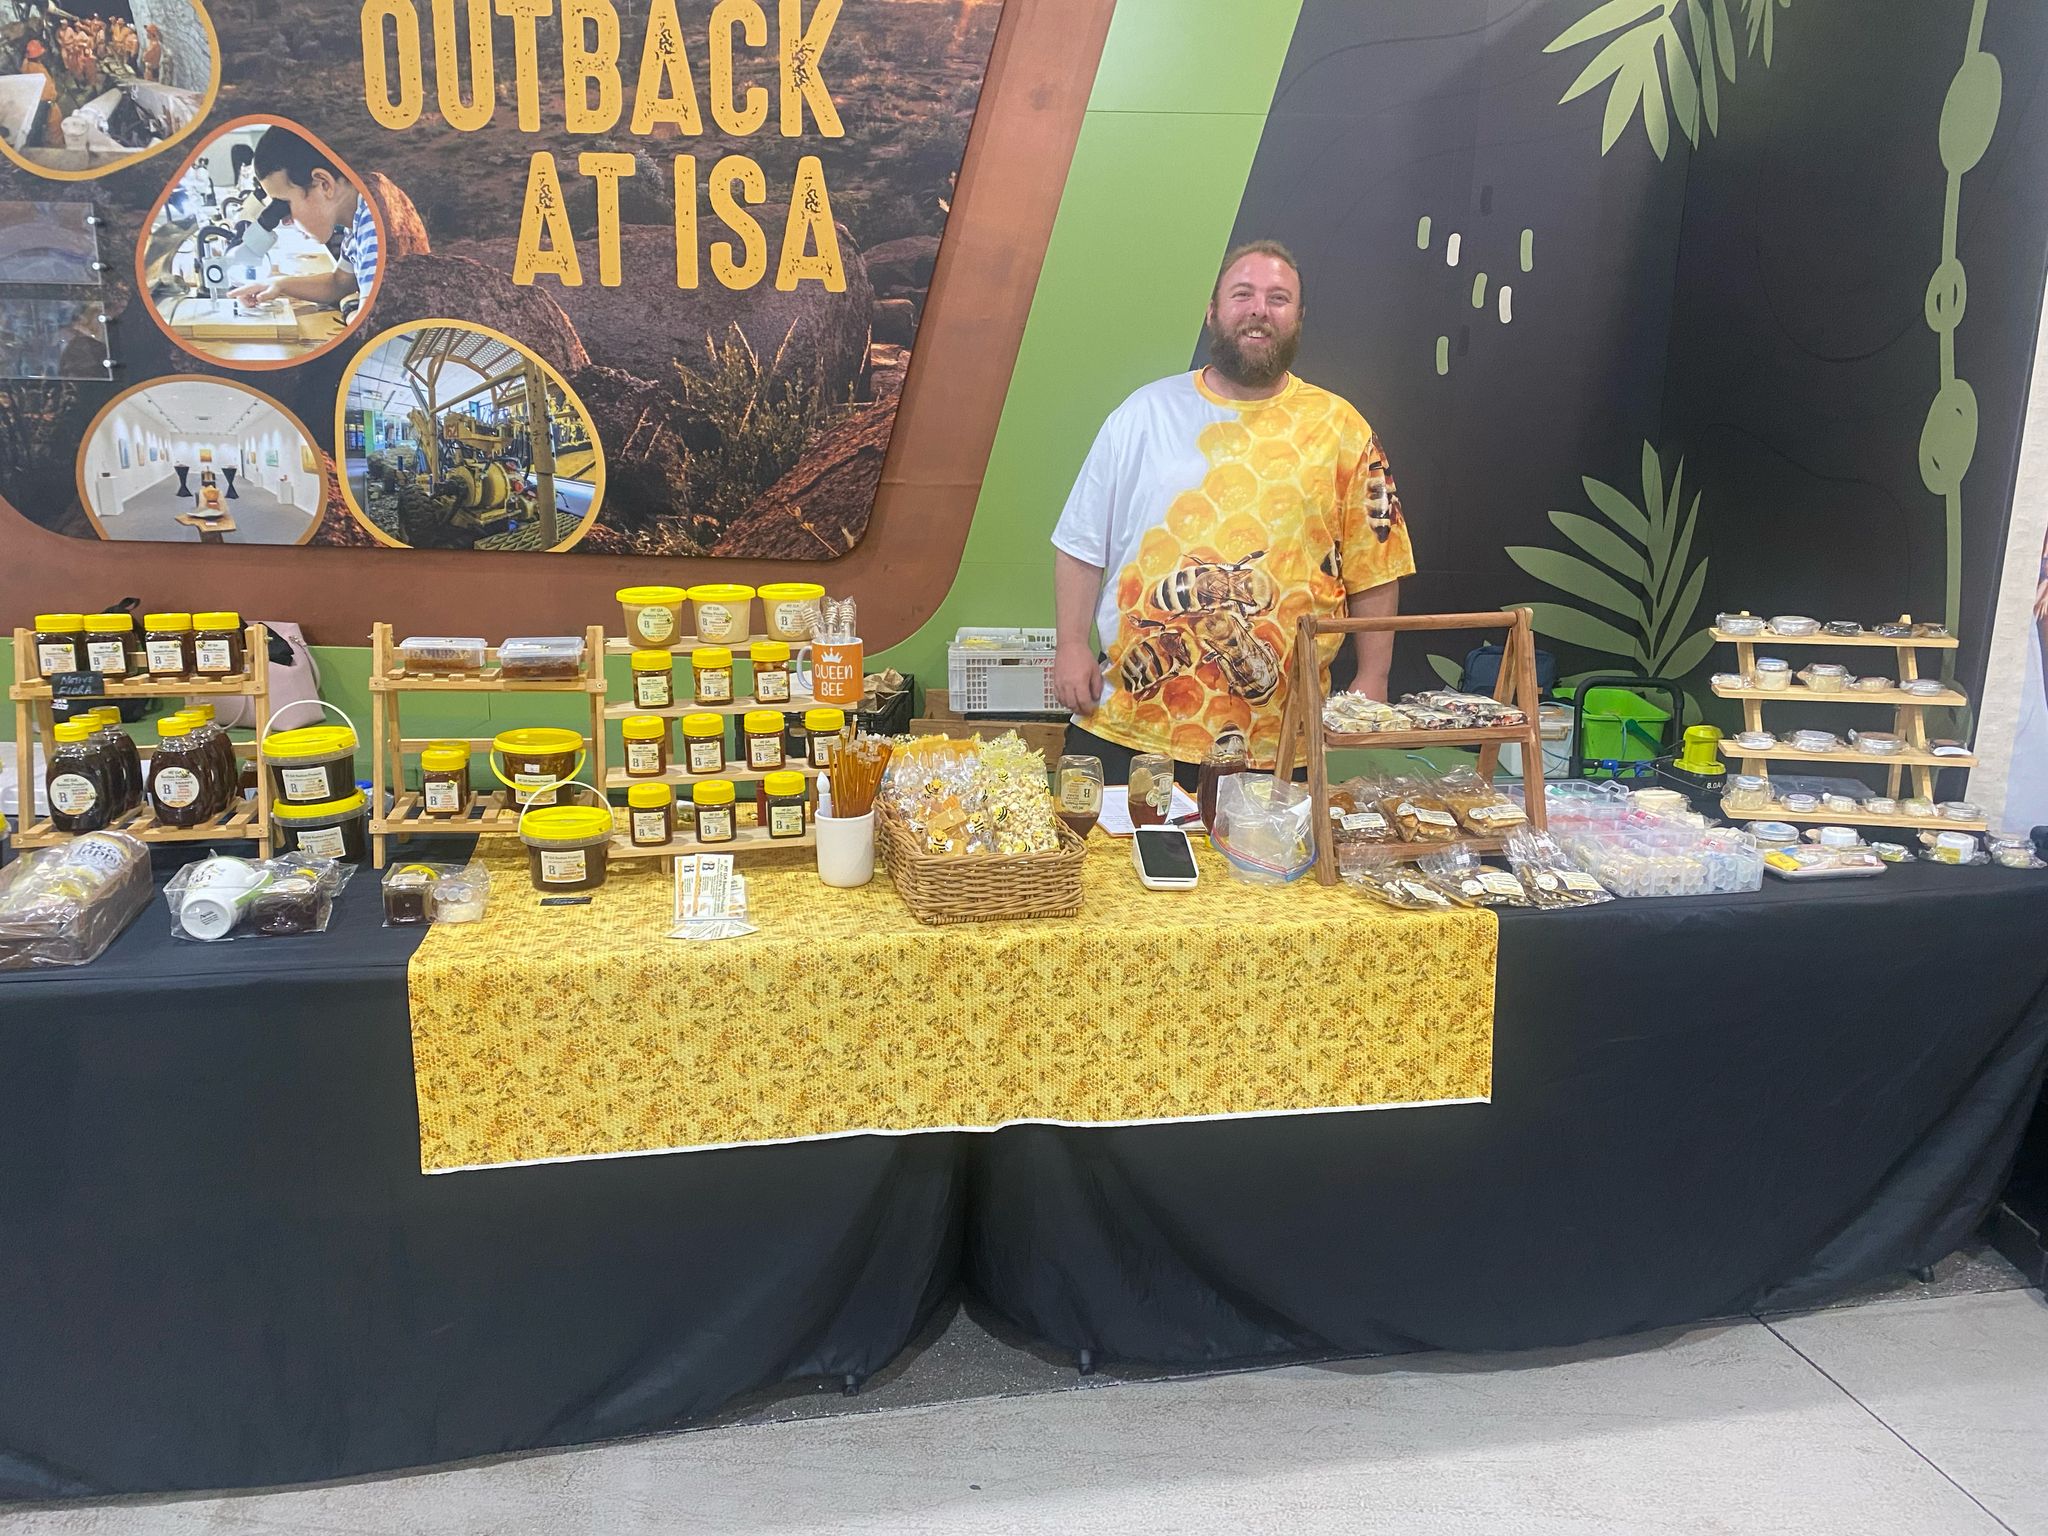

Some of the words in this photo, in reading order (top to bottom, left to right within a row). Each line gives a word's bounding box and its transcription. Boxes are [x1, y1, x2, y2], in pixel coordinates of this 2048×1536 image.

[360, 0, 846, 137] OUTBACK
[512, 151, 637, 287] AT
[674, 153, 847, 293] ISA
[815, 664, 853, 680] QUEEN
[821, 682, 845, 696] BEE
